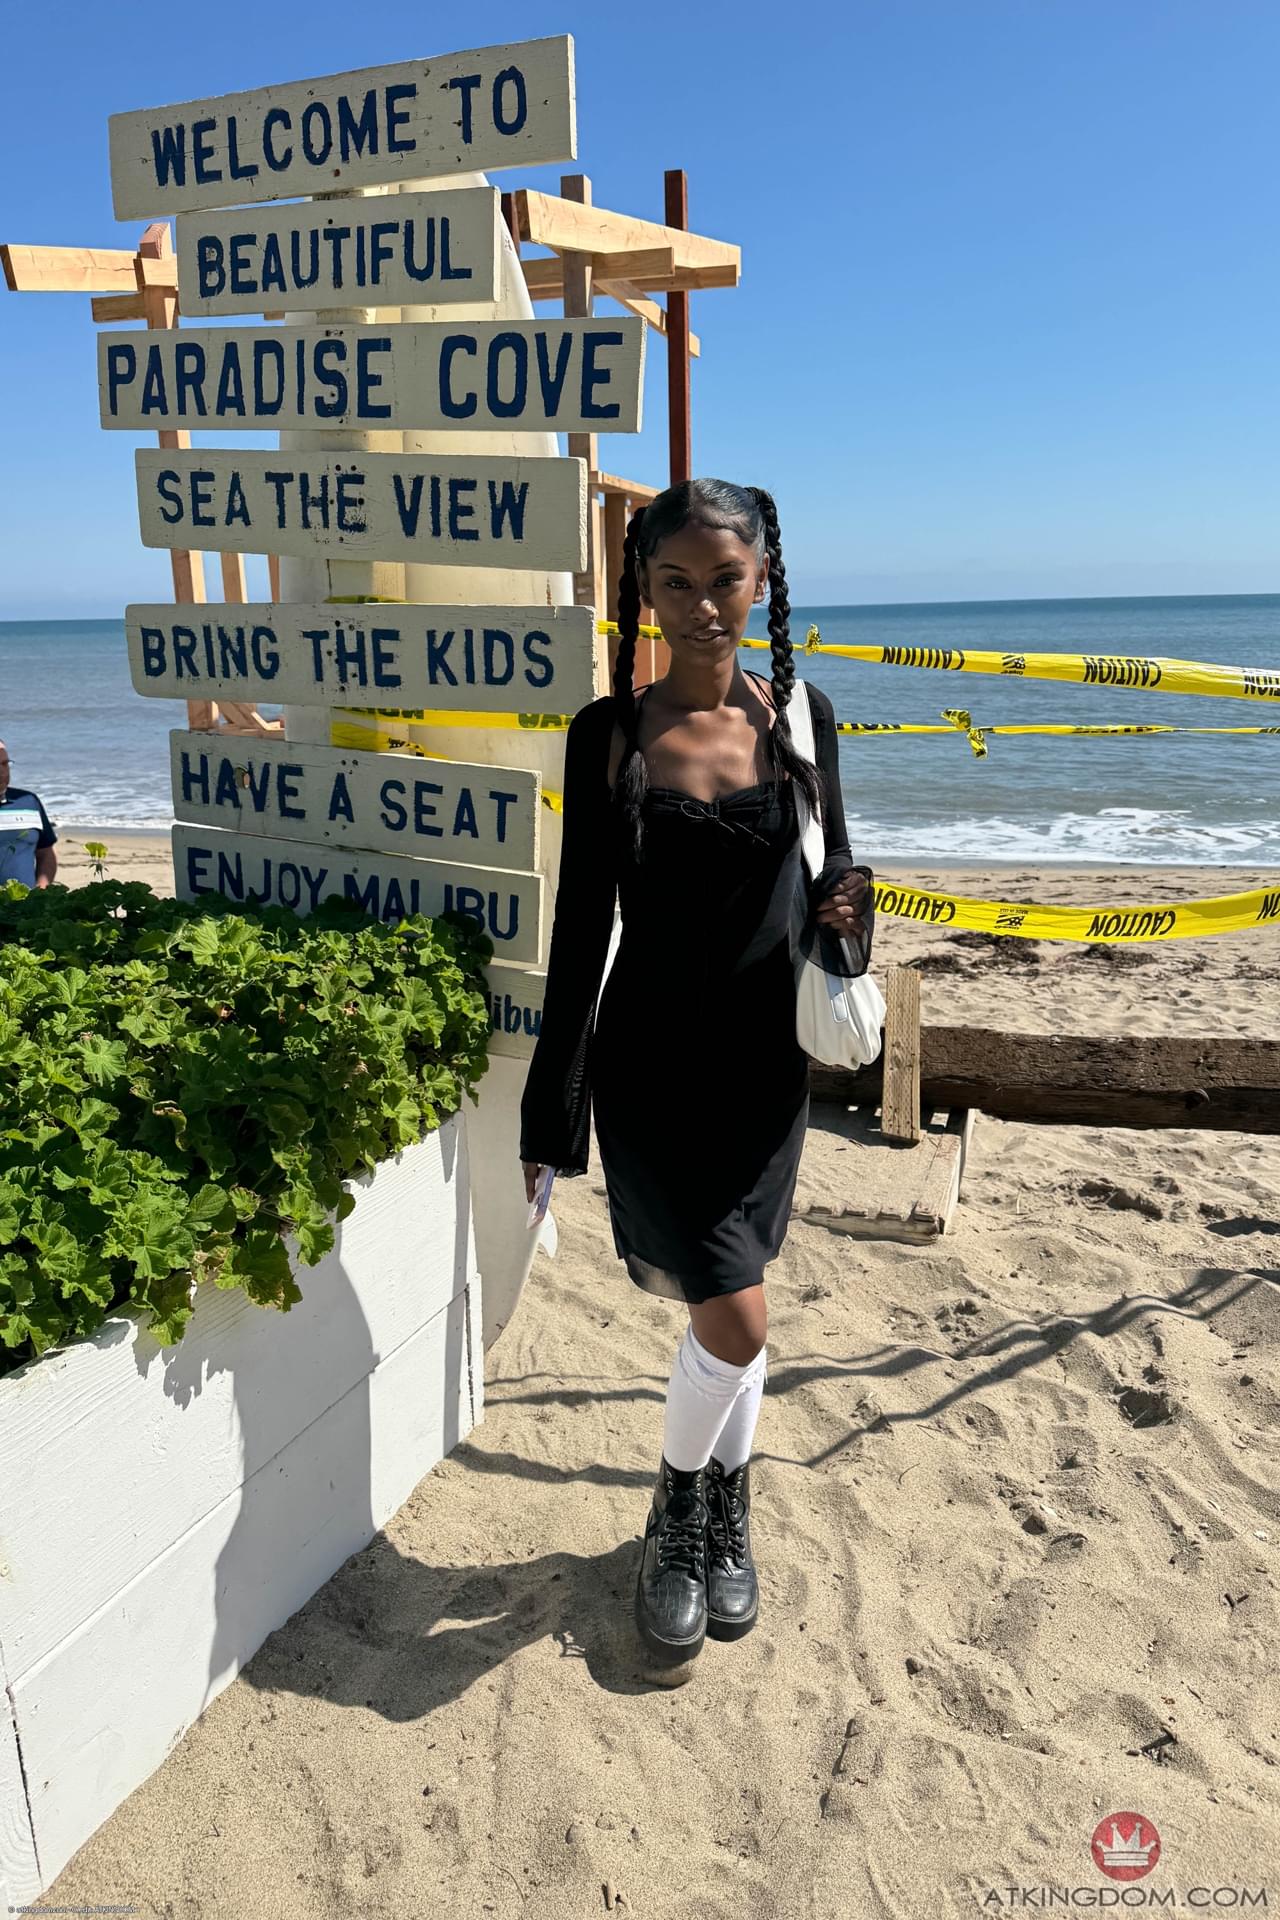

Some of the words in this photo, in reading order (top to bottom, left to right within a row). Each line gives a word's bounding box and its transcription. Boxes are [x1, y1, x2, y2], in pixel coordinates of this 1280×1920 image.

[151, 83, 416, 187] WELCOME
[449, 66, 527, 144] TO
[197, 217, 472, 298] BEAUTIFUL
[108, 338, 391, 418] PARADISE
[439, 332, 623, 419] COVE
[157, 470, 251, 527] SEA
[265, 472, 366, 533] THE
[393, 475, 529, 541] VIEW
[141, 626, 280, 680] BRING
[302, 628, 401, 688] THE
[427, 629, 554, 688] KIDS
[1083, 657, 1162, 687] CAUTION
[181, 752, 306, 819] HAVE
[328, 773, 355, 823] A
[380, 780, 518, 843] SEAT
[187, 847, 328, 913] ENJOY
[1086, 910, 1176, 937] CAUTION
